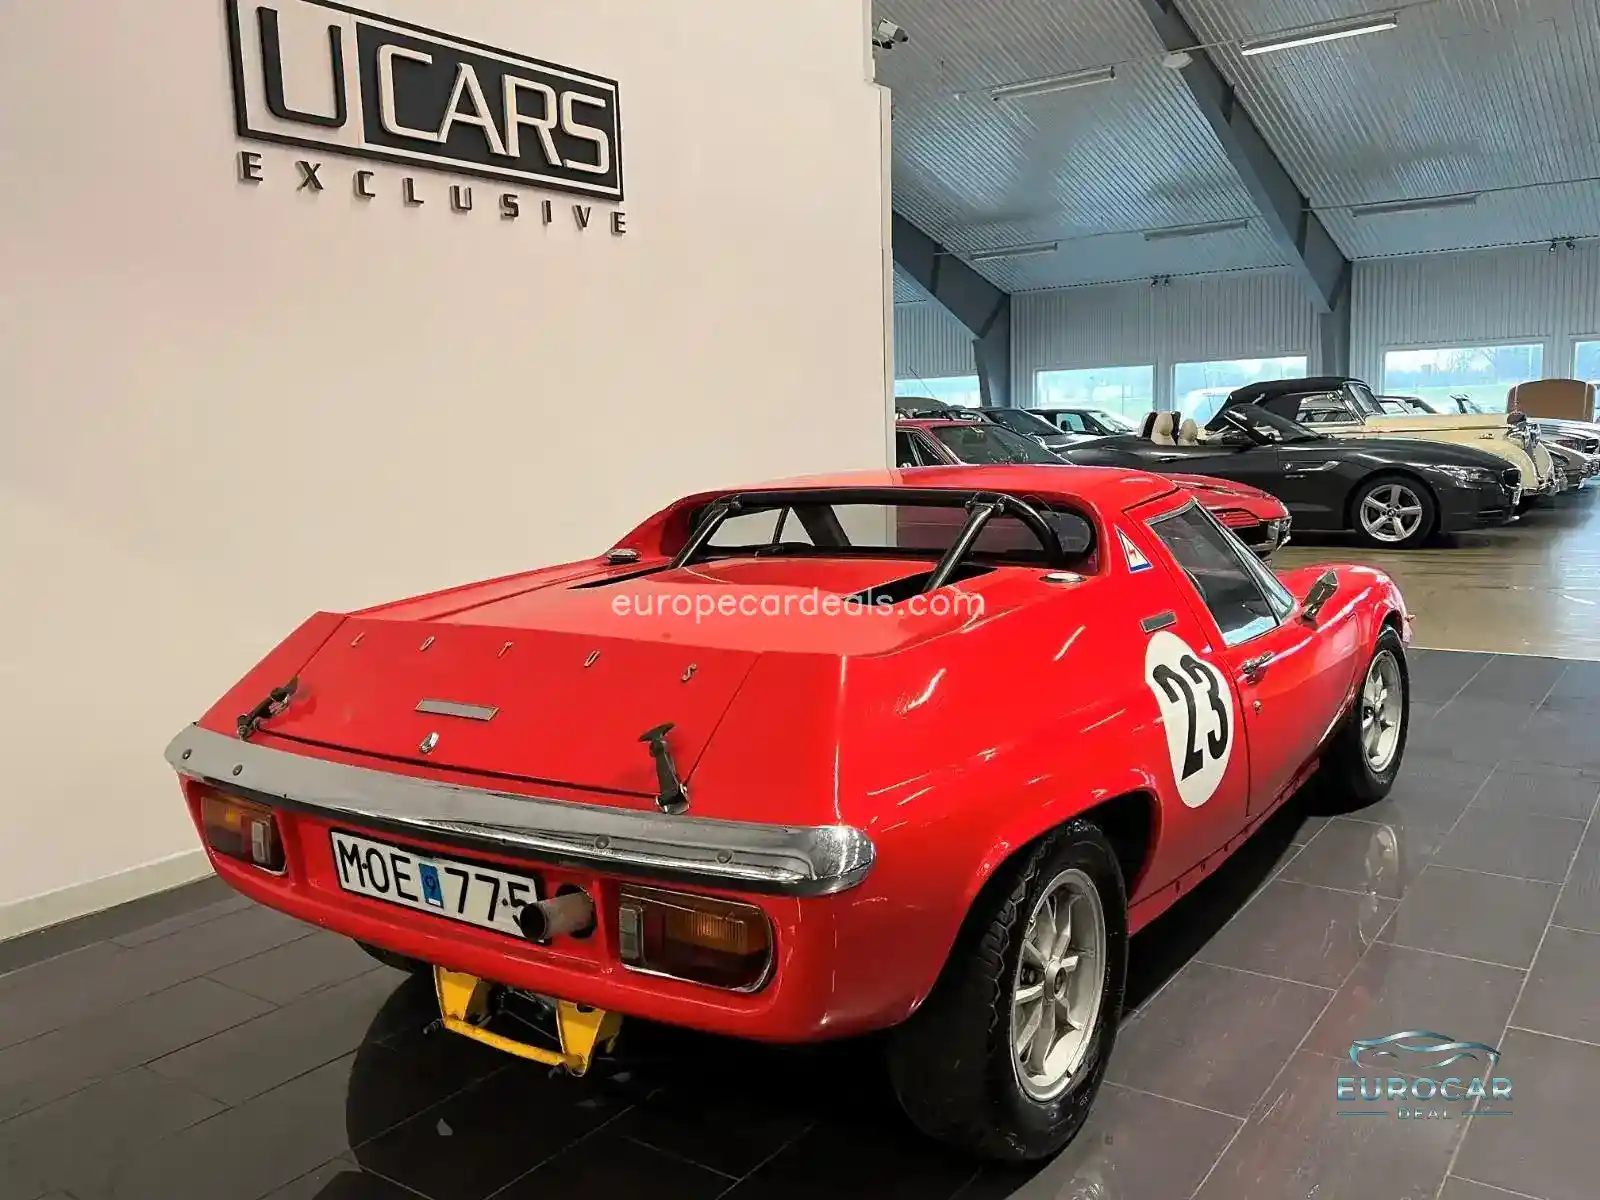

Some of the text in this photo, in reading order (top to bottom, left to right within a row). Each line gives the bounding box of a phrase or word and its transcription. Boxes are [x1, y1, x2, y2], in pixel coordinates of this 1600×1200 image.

[238, 151, 627, 234] EXCLUSIVE
[350, 632, 698, 683] LOTUS
[1152, 654, 1229, 781] 23
[337, 839, 418, 902] MOE
